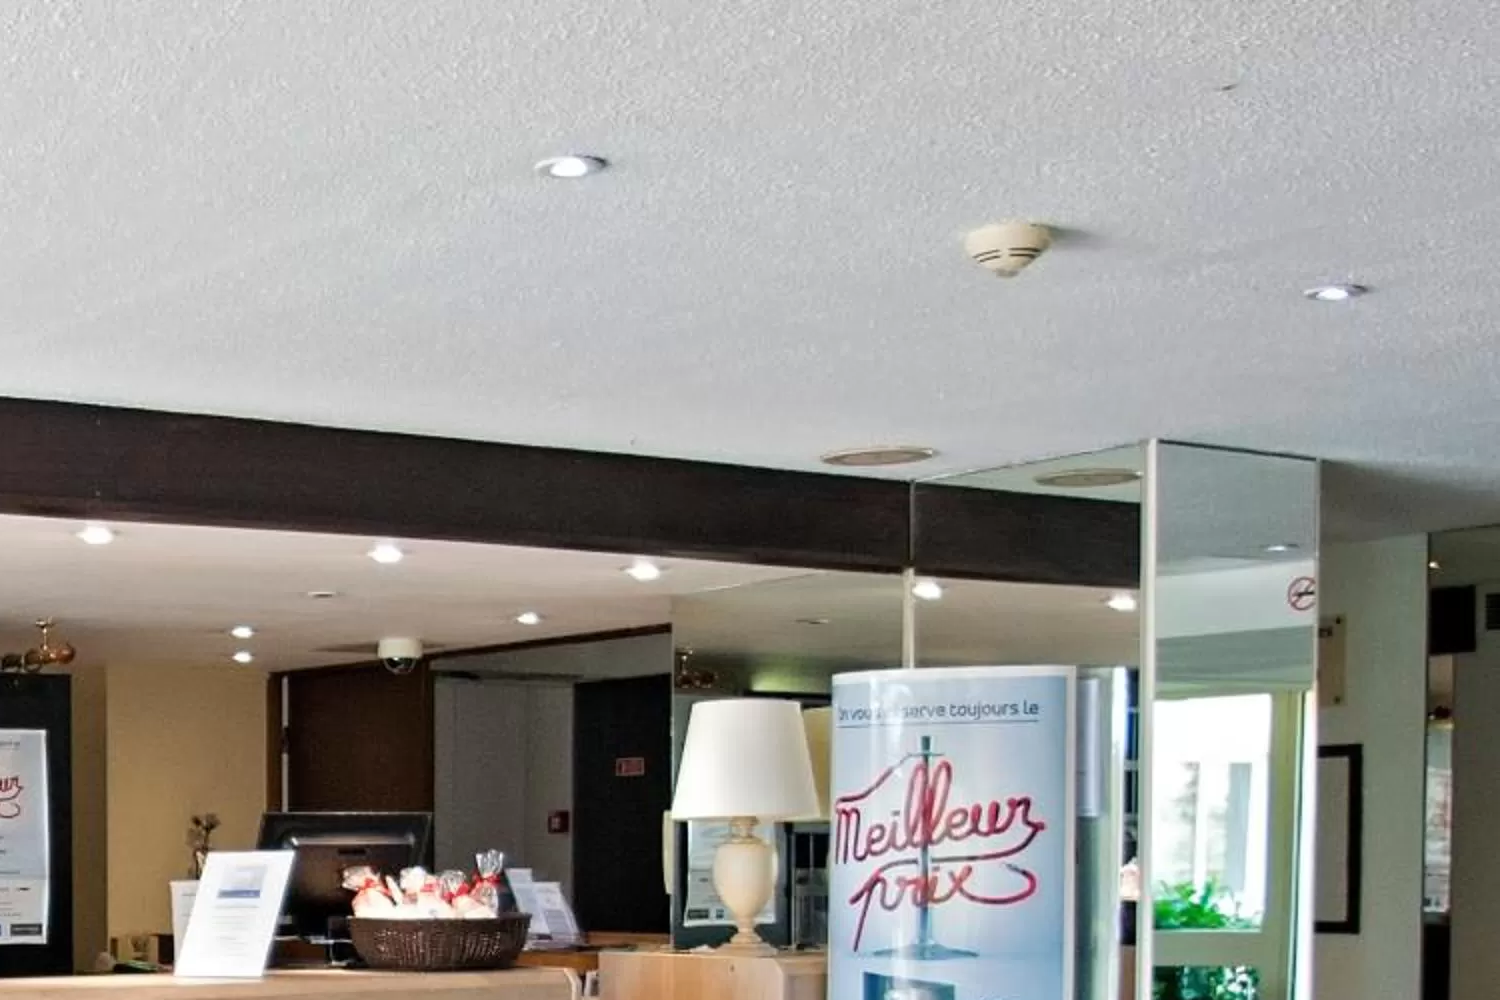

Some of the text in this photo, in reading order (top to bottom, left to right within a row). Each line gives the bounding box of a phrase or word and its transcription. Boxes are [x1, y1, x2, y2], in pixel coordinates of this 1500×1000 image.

[949, 701, 1019, 720] toujours
[1023, 700, 1040, 715] le
[835, 758, 1046, 865] Meilleur
[849, 862, 1038, 952] prix
